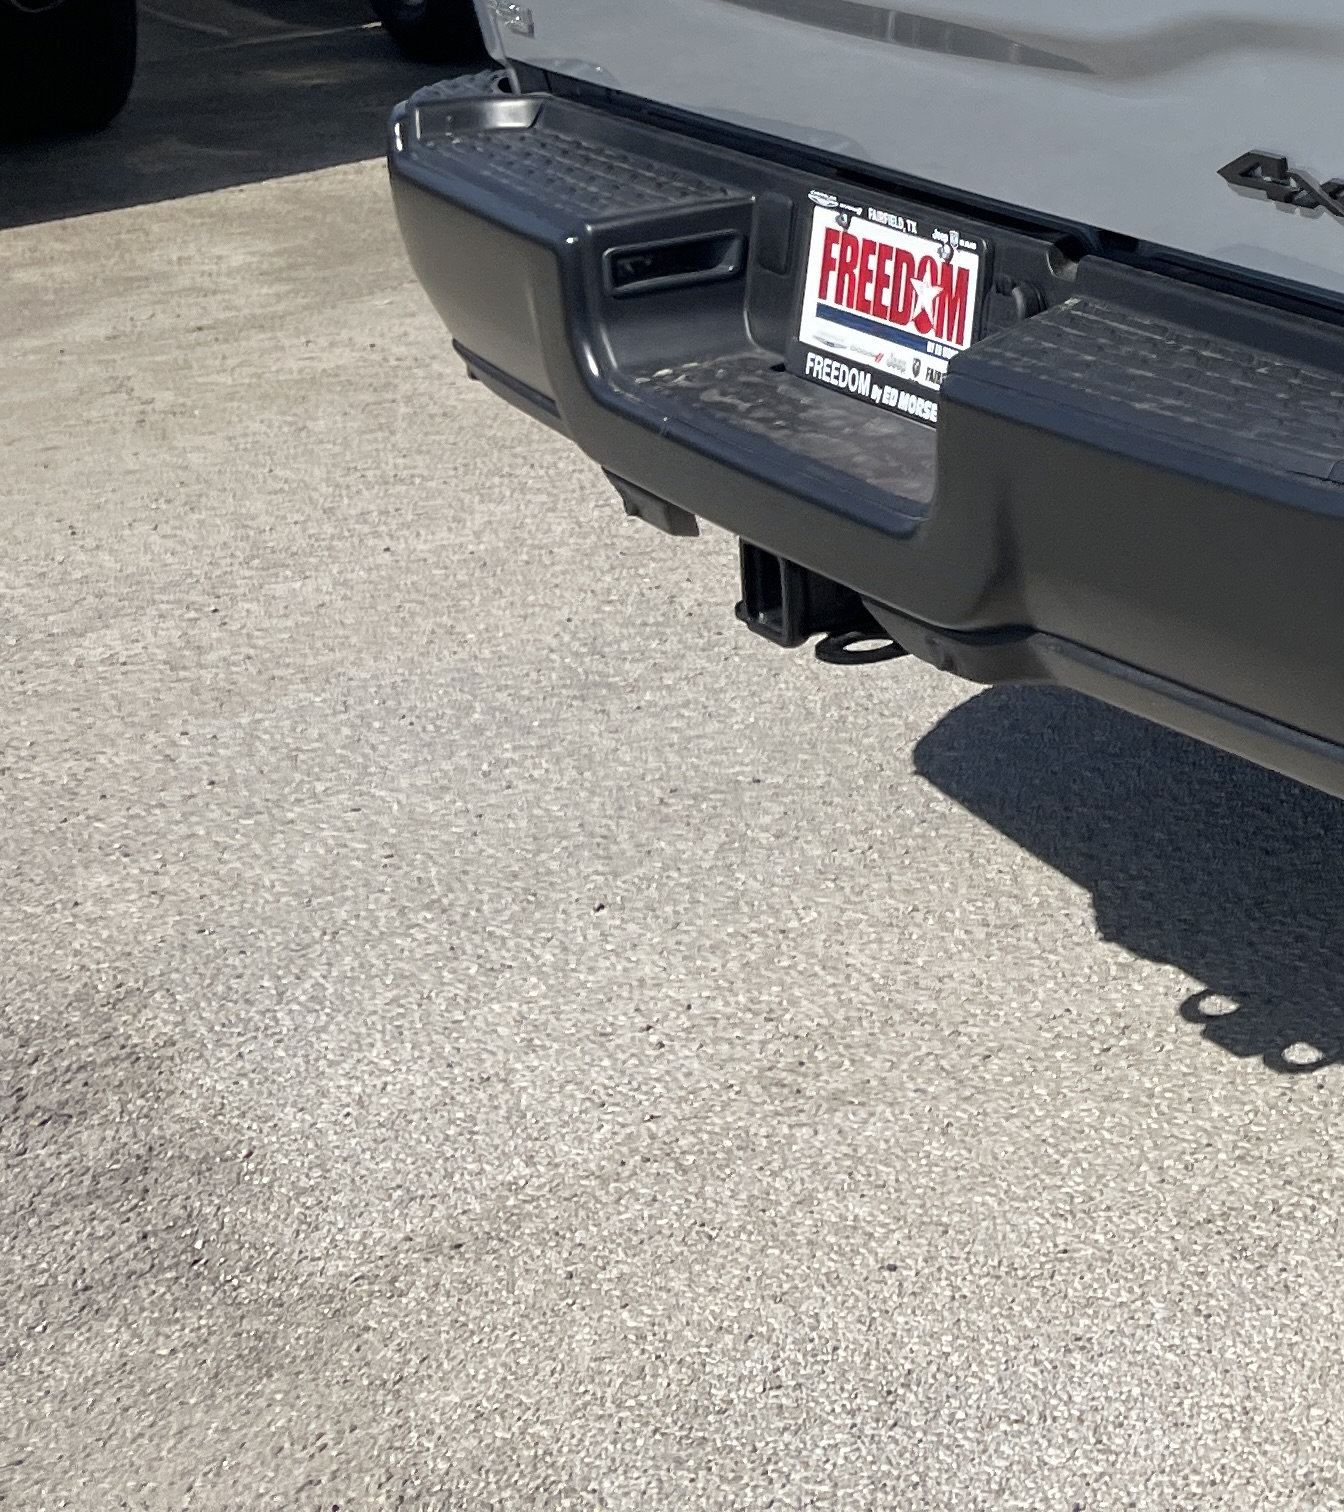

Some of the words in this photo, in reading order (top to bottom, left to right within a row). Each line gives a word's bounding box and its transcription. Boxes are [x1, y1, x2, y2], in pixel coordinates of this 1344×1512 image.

[817, 226, 970, 346] FREEDOM
[805, 351, 872, 397] FREEDOM
[882, 385, 899, 407] ED
[898, 390, 939, 423] MORSE
